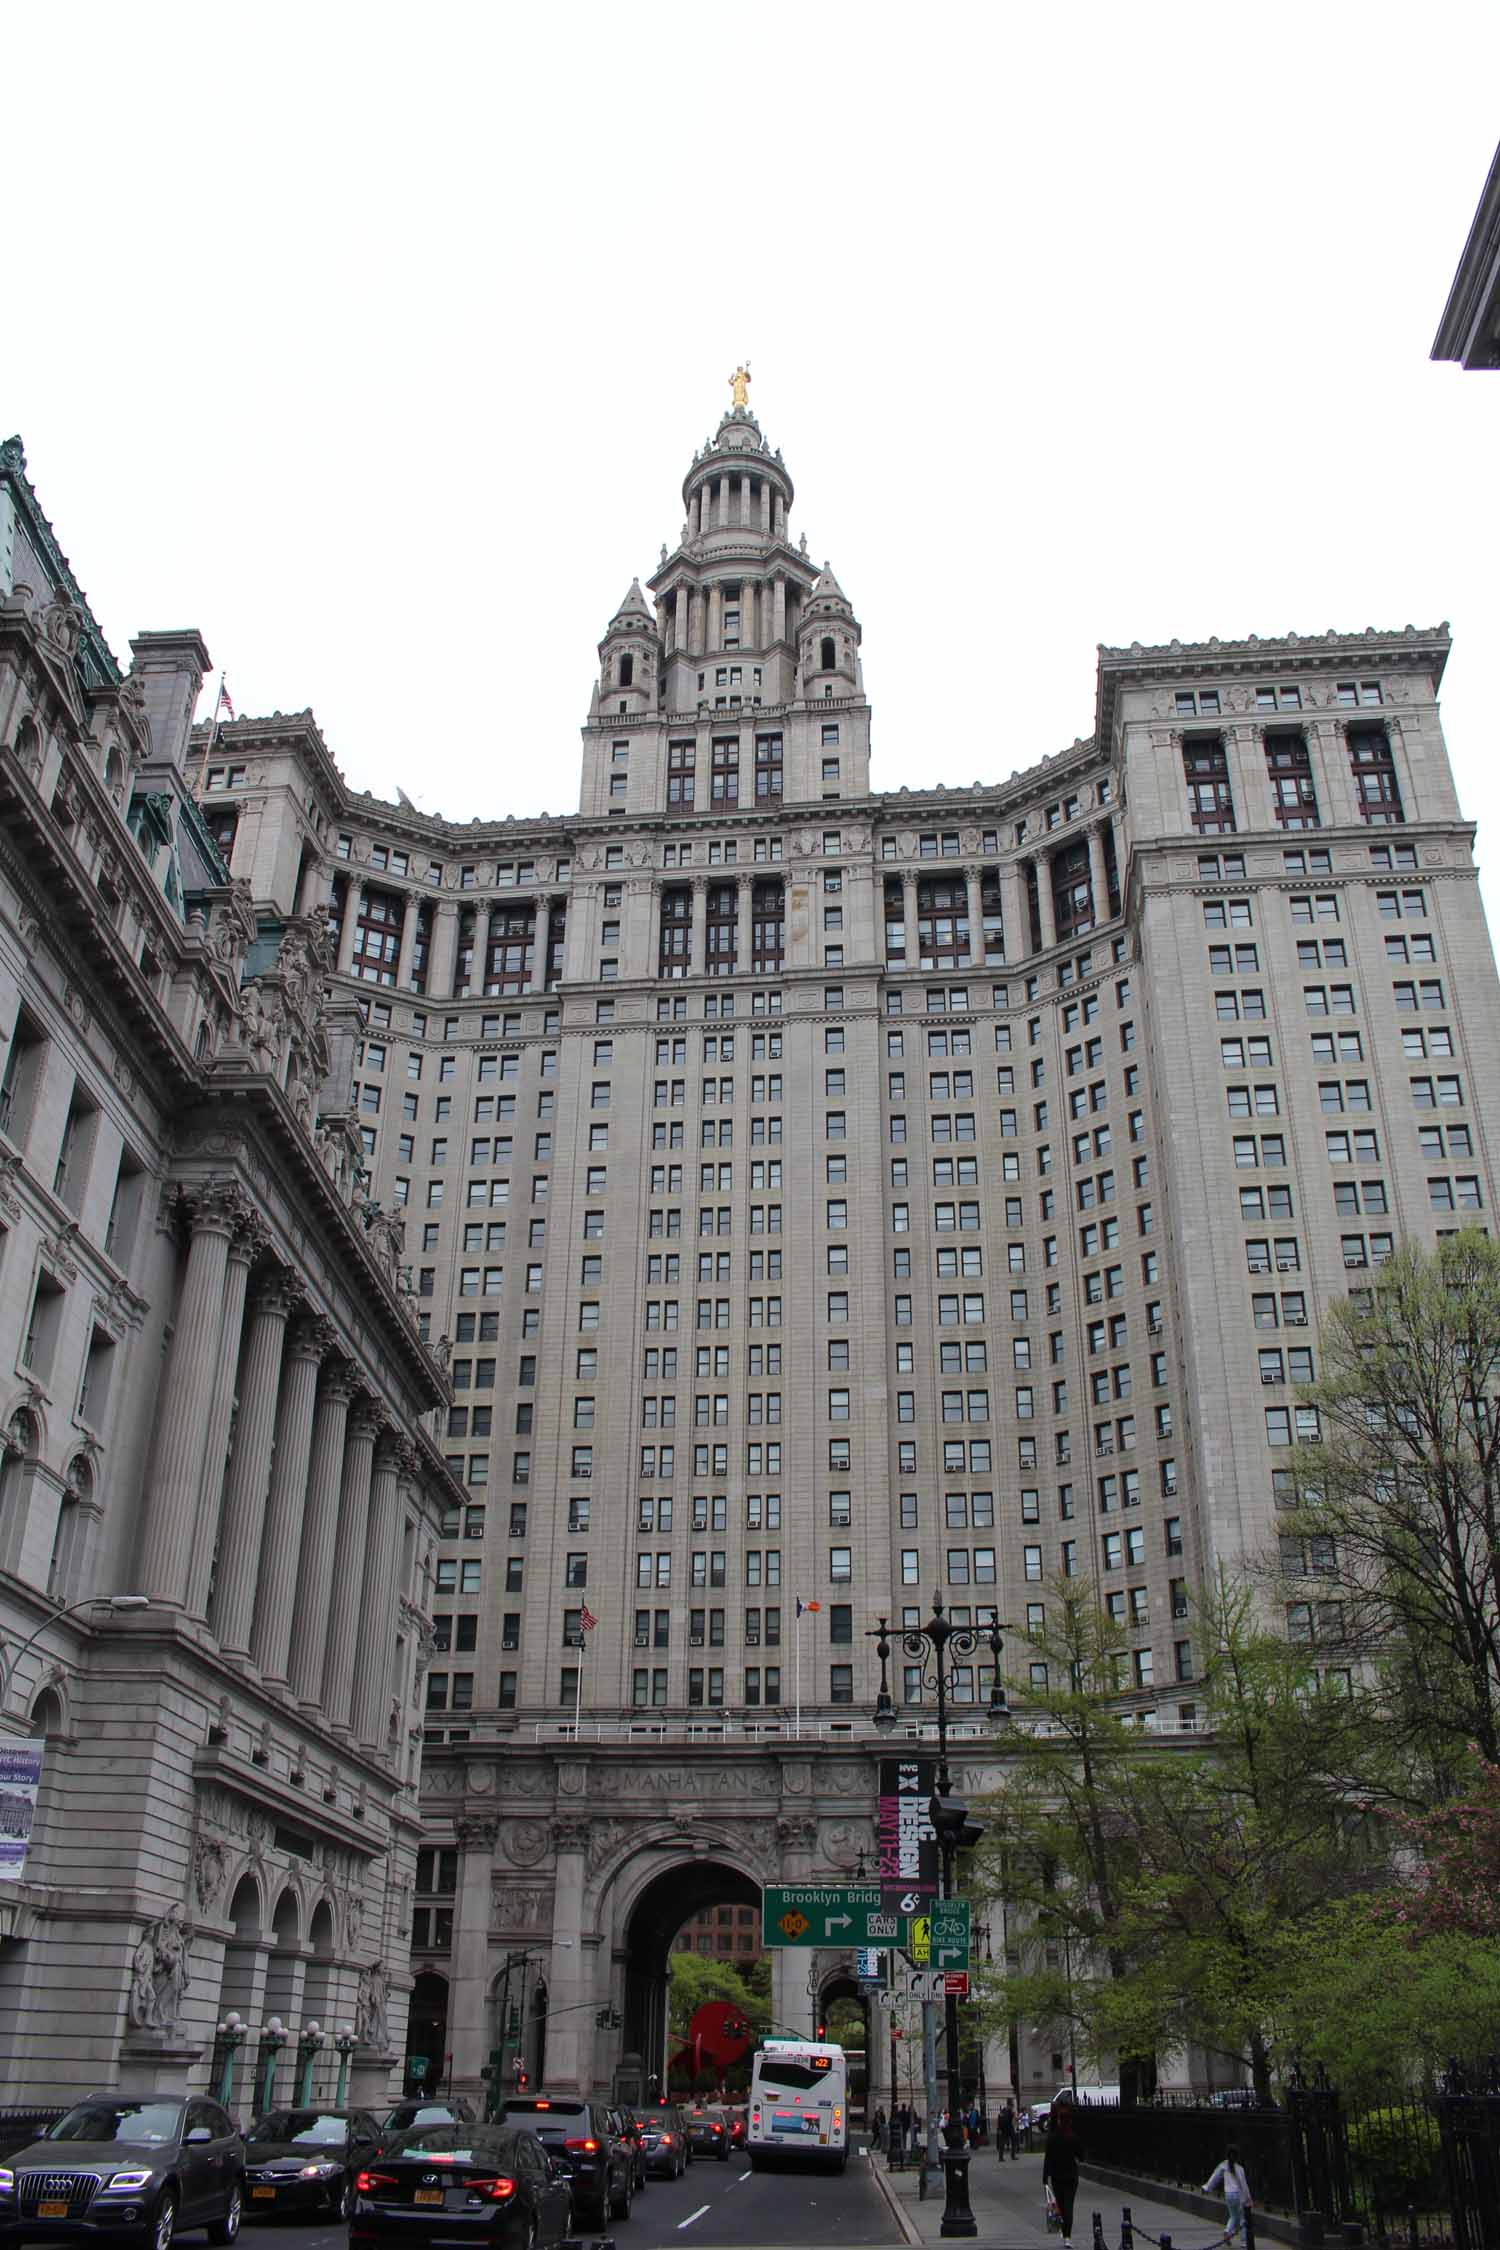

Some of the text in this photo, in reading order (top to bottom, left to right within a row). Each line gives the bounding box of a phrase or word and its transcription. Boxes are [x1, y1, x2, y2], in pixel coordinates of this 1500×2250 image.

[14, 1756, 40, 1766] History
[0, 1773, 34, 1784] our Story
[625, 1772, 748, 1791] MANHATTAN
[880, 1797, 898, 1832] MAY
[898, 1796, 920, 1879] DESIGN
[782, 1891, 881, 1906] Brooklyn Bridg
[868, 1925, 896, 1936] ONLY
[908, 1992, 926, 2000] ONLY
[931, 1992, 945, 2000] ONL
